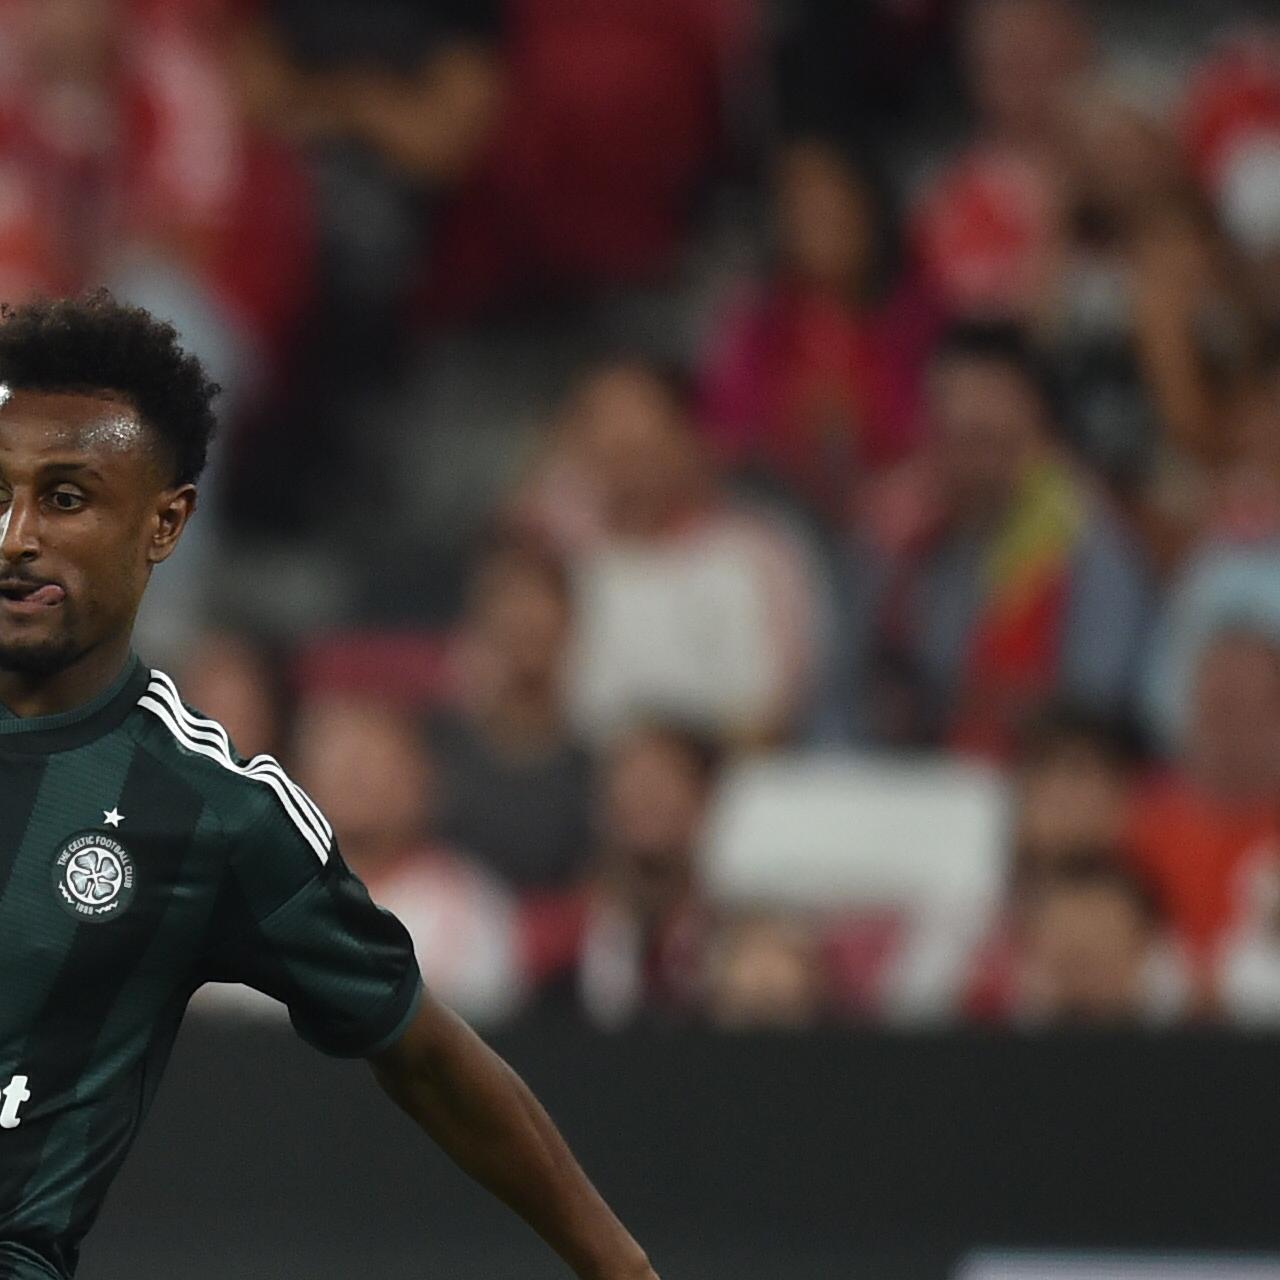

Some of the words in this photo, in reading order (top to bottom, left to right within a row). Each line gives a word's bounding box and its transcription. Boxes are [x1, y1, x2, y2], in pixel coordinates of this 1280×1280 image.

[57, 849, 71, 866] THE
[68, 836, 95, 852] CELTIC
[95, 836, 131, 866] FOOTBALL
[123, 866, 133, 889] CLUB
